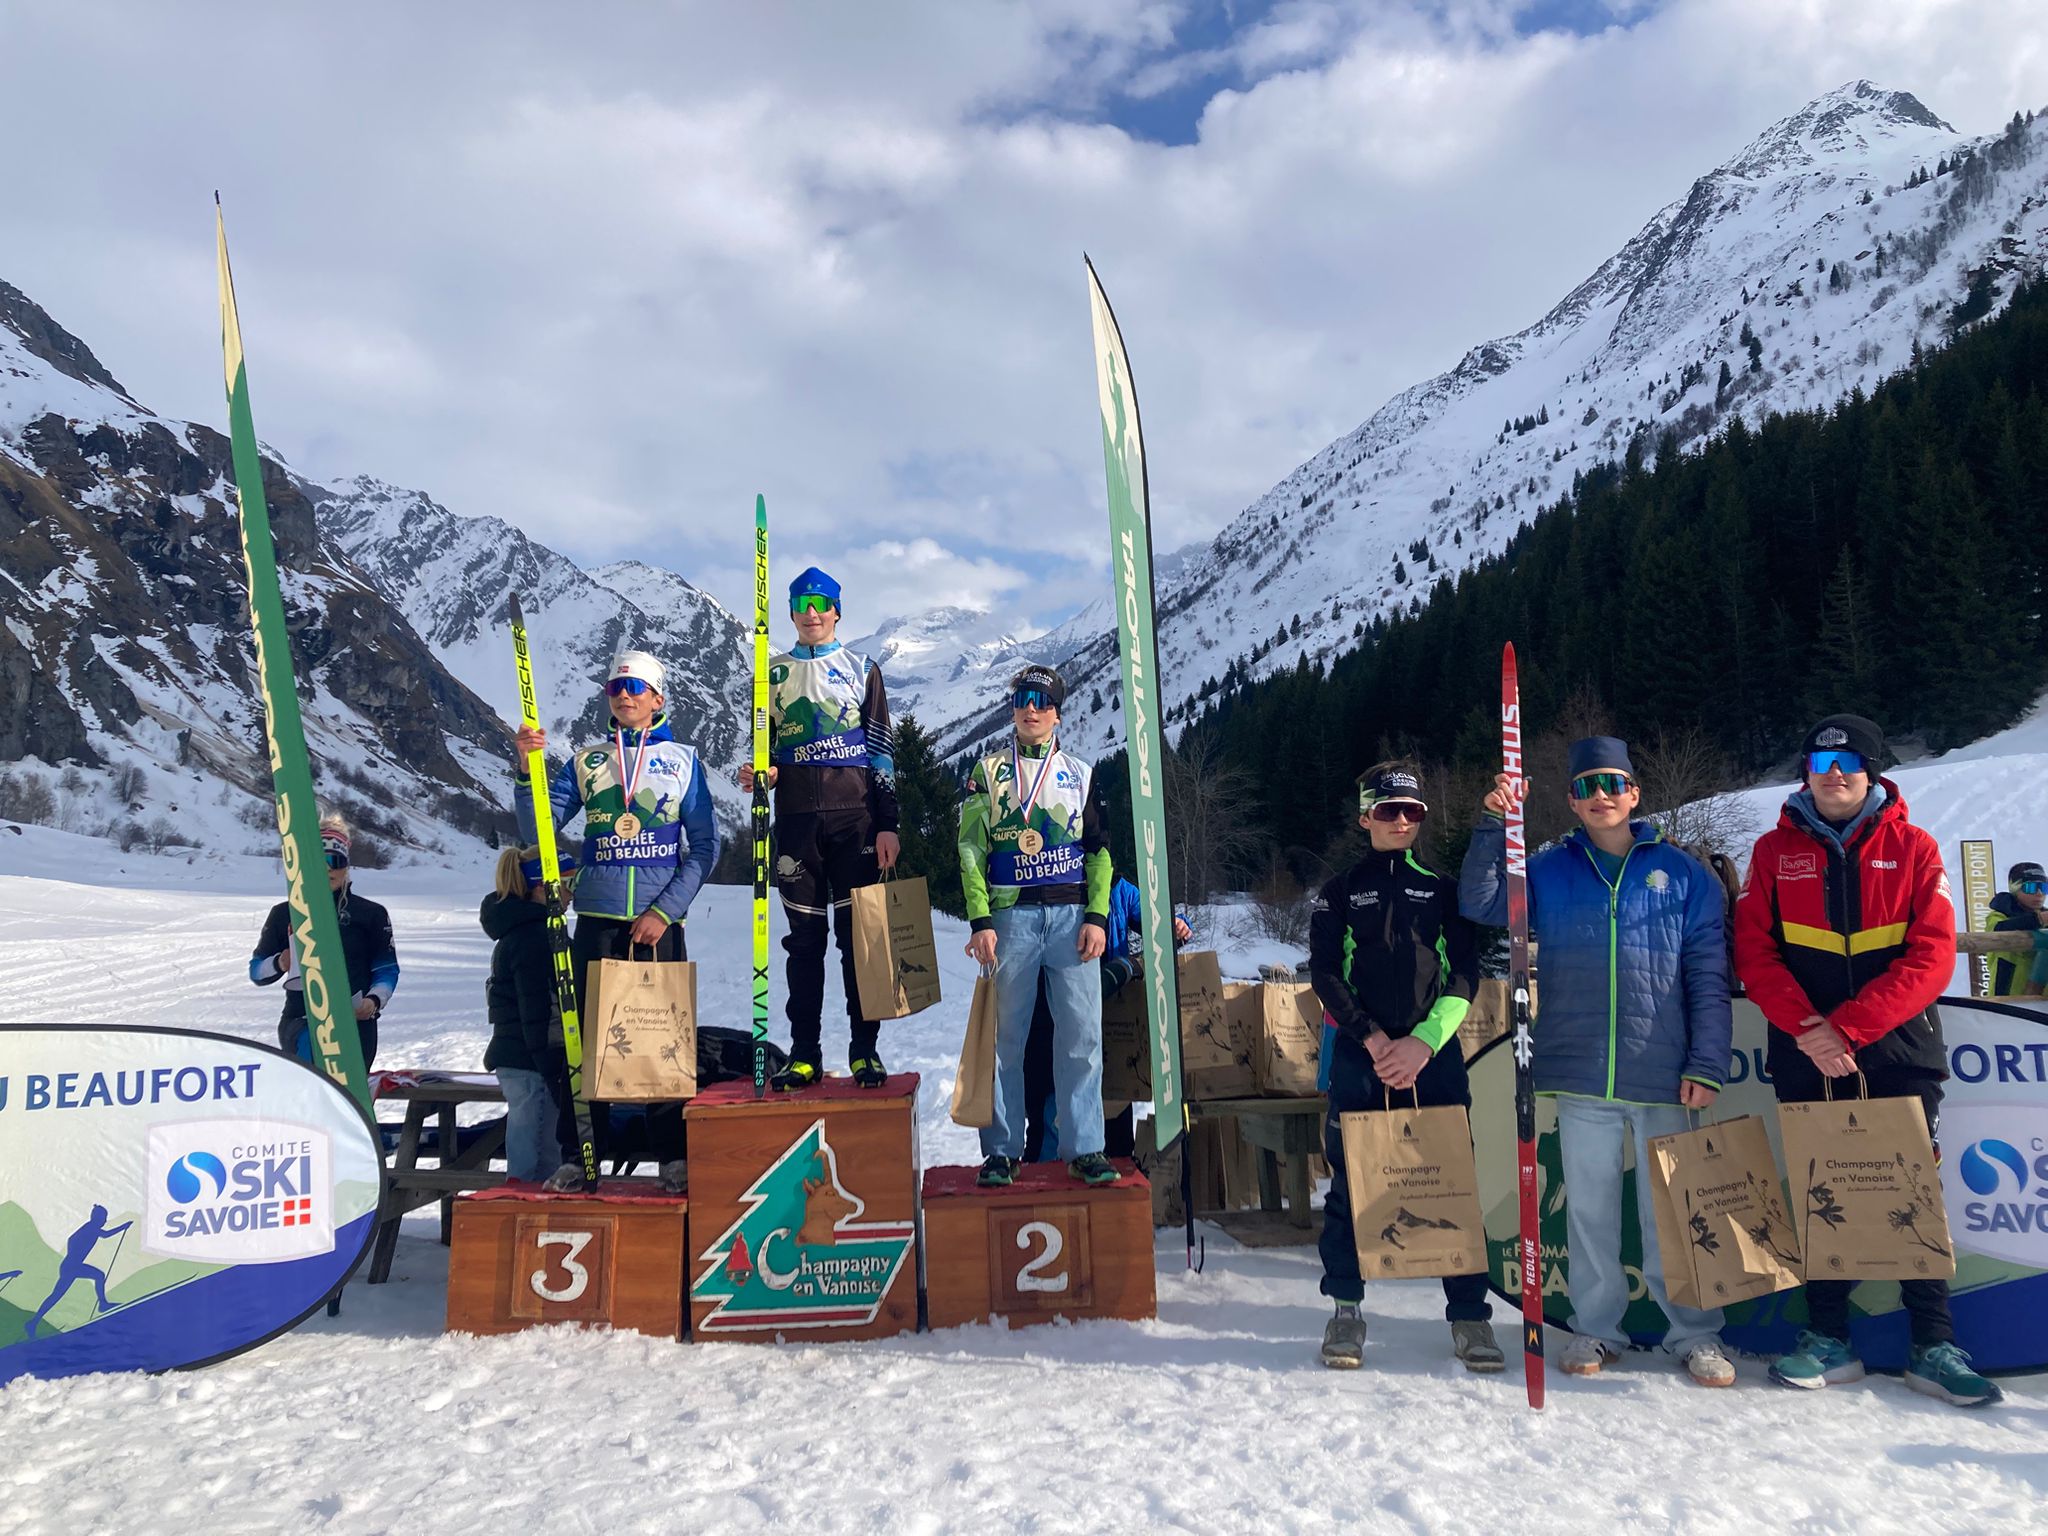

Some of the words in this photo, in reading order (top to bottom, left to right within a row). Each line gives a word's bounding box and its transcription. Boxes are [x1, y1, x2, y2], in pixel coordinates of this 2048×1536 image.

[756, 527, 767, 612] FISCHER
[513, 626, 536, 721] FISCHER
[772, 666, 781, 681] 1
[794, 734, 846, 754] TROPHÉE
[591, 751, 605, 767] 3
[999, 764, 1011, 781] 2
[1502, 703, 1526, 877] MADSHUS
[622, 820, 633, 831] 3
[596, 829, 656, 849] TROPHÉE
[1026, 835, 1035, 847] 2
[596, 850, 612, 862] DU
[615, 842, 678, 860] BEAUFORT
[1013, 845, 1071, 867] TROPHÉE
[1969, 843, 1987, 877] PONT
[1015, 867, 1033, 881] DU
[1972, 881, 1989, 898] DU
[277, 792, 348, 1086] FROMAGE
[623, 1005, 670, 1016] Champagny
[753, 966, 768, 1041] MAX
[637, 1017, 668, 1025] Vanoise
[755, 1047, 765, 1086] SPEED
[25, 1063, 261, 1111] BEAUFORT
[231, 1140, 312, 1160] COMITE
[582, 1141, 596, 1182] SPEED
[1382, 1165, 1441, 1176] Champagny
[1826, 1160, 1896, 1171] Champagny
[230, 1155, 311, 1200] SKI
[1387, 1181, 1400, 1189] en
[1401, 1177, 1440, 1188] Vanoise
[1848, 1174, 1895, 1183] Vanoise
[1696, 1179, 1748, 1198] Champagny
[1703, 1202, 1715, 1211] en
[1714, 1194, 1750, 1208] Vanoise
[164, 1200, 280, 1239] SAVOIE
[530, 1231, 593, 1301] 3
[757, 1227, 892, 1291] Champagny
[1014, 1221, 1068, 1293] 2
[1525, 1239, 1536, 1286] REDLINE
[792, 1280, 814, 1296] en
[815, 1274, 881, 1296] Vanoise
